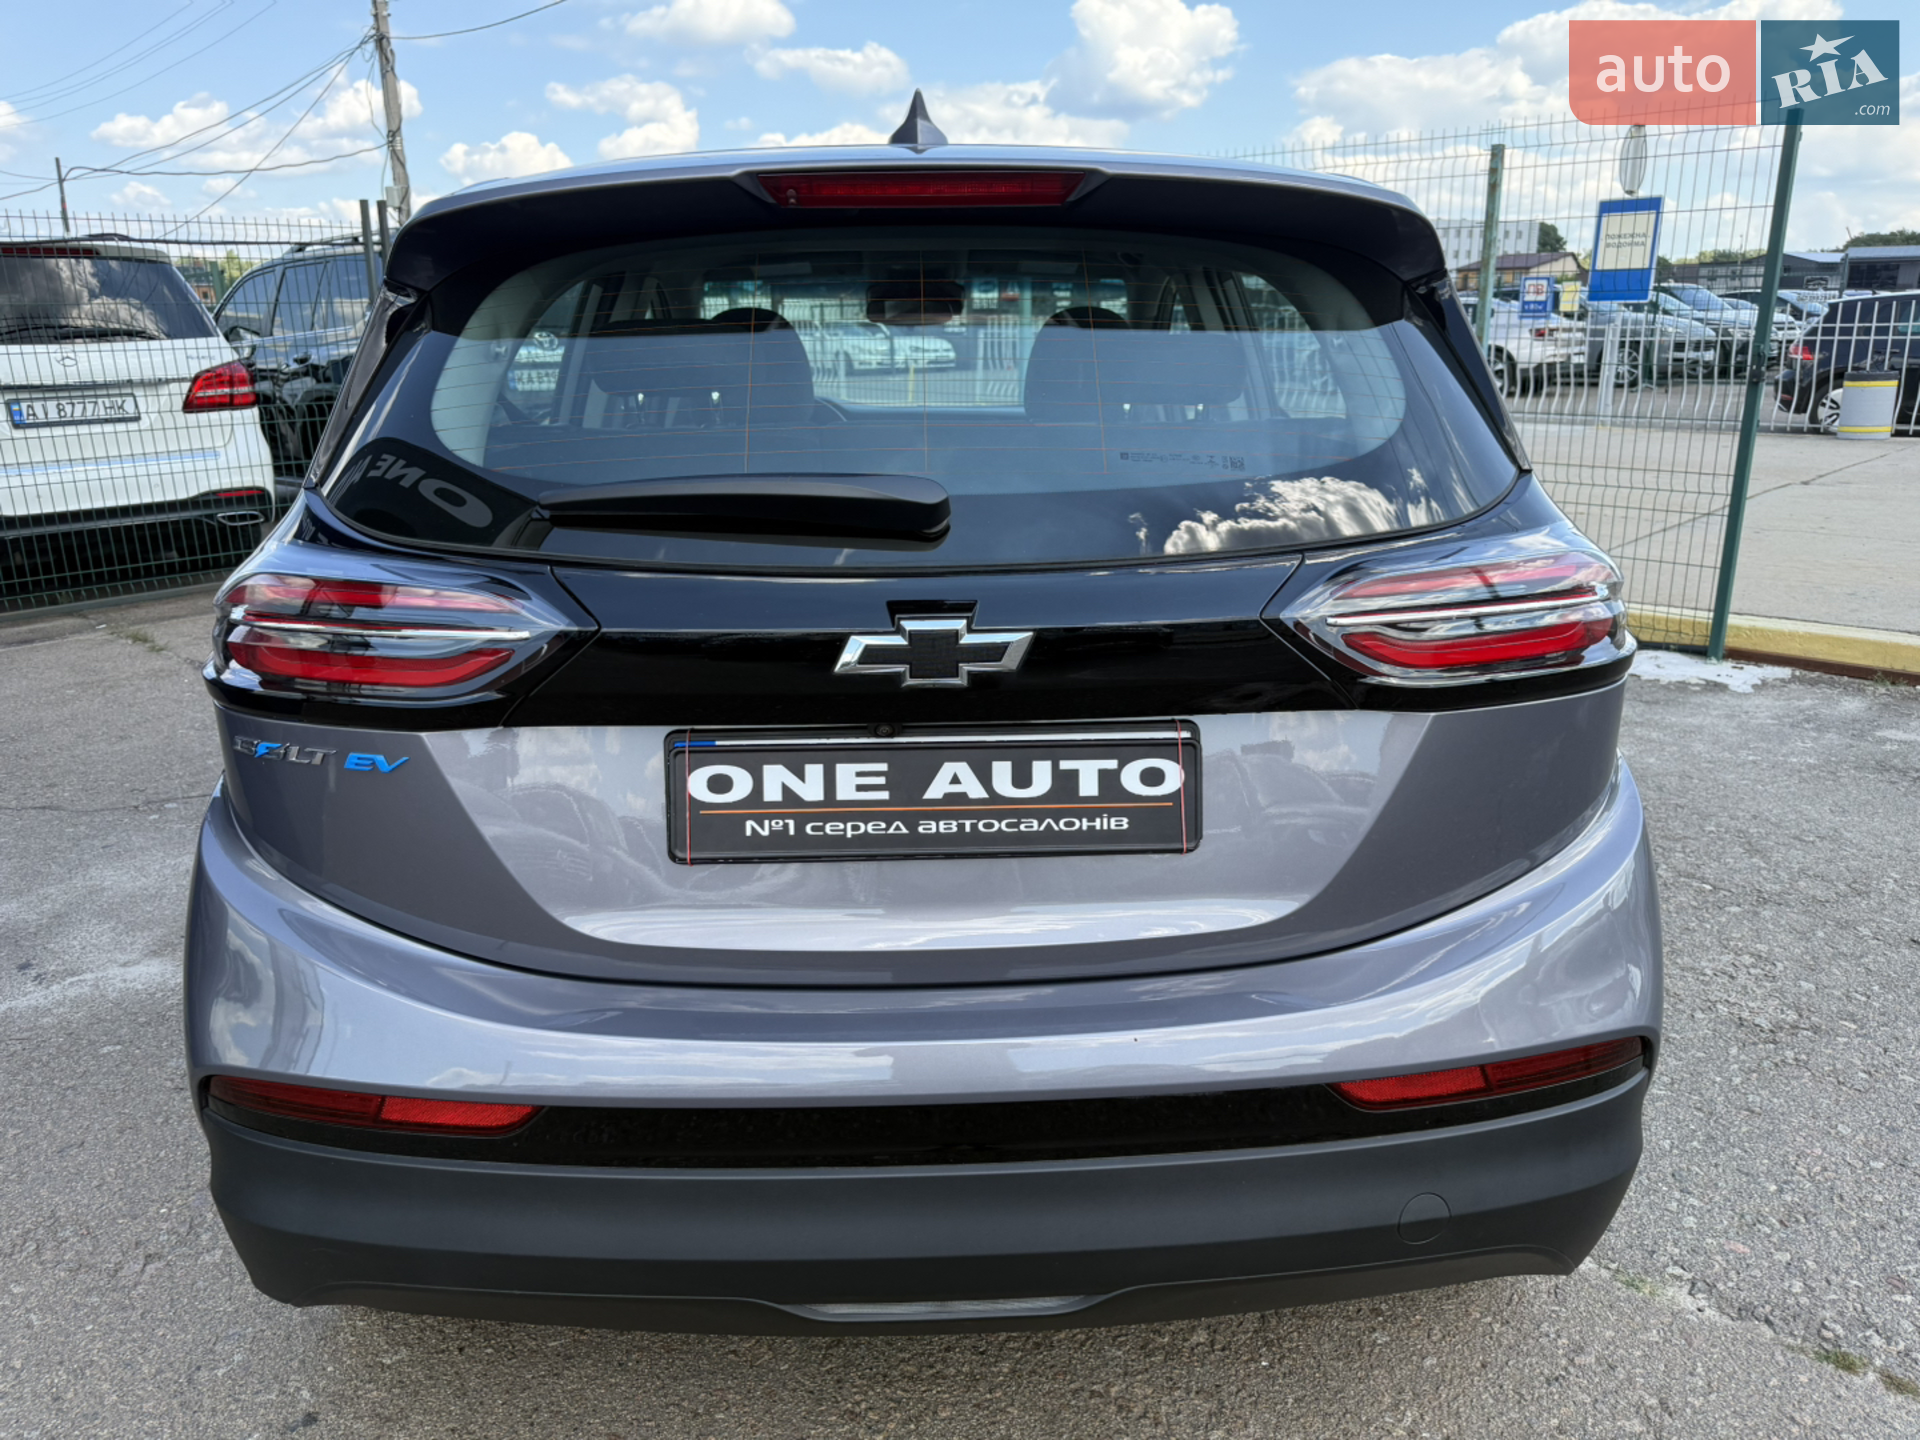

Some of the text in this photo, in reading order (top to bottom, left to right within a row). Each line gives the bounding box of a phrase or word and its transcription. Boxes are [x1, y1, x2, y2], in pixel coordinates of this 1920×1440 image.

[343, 752, 410, 774] EV
[688, 757, 1185, 804] ONE AUTO
[806, 819, 910, 839] серед
[917, 813, 1130, 834] автосалонів
